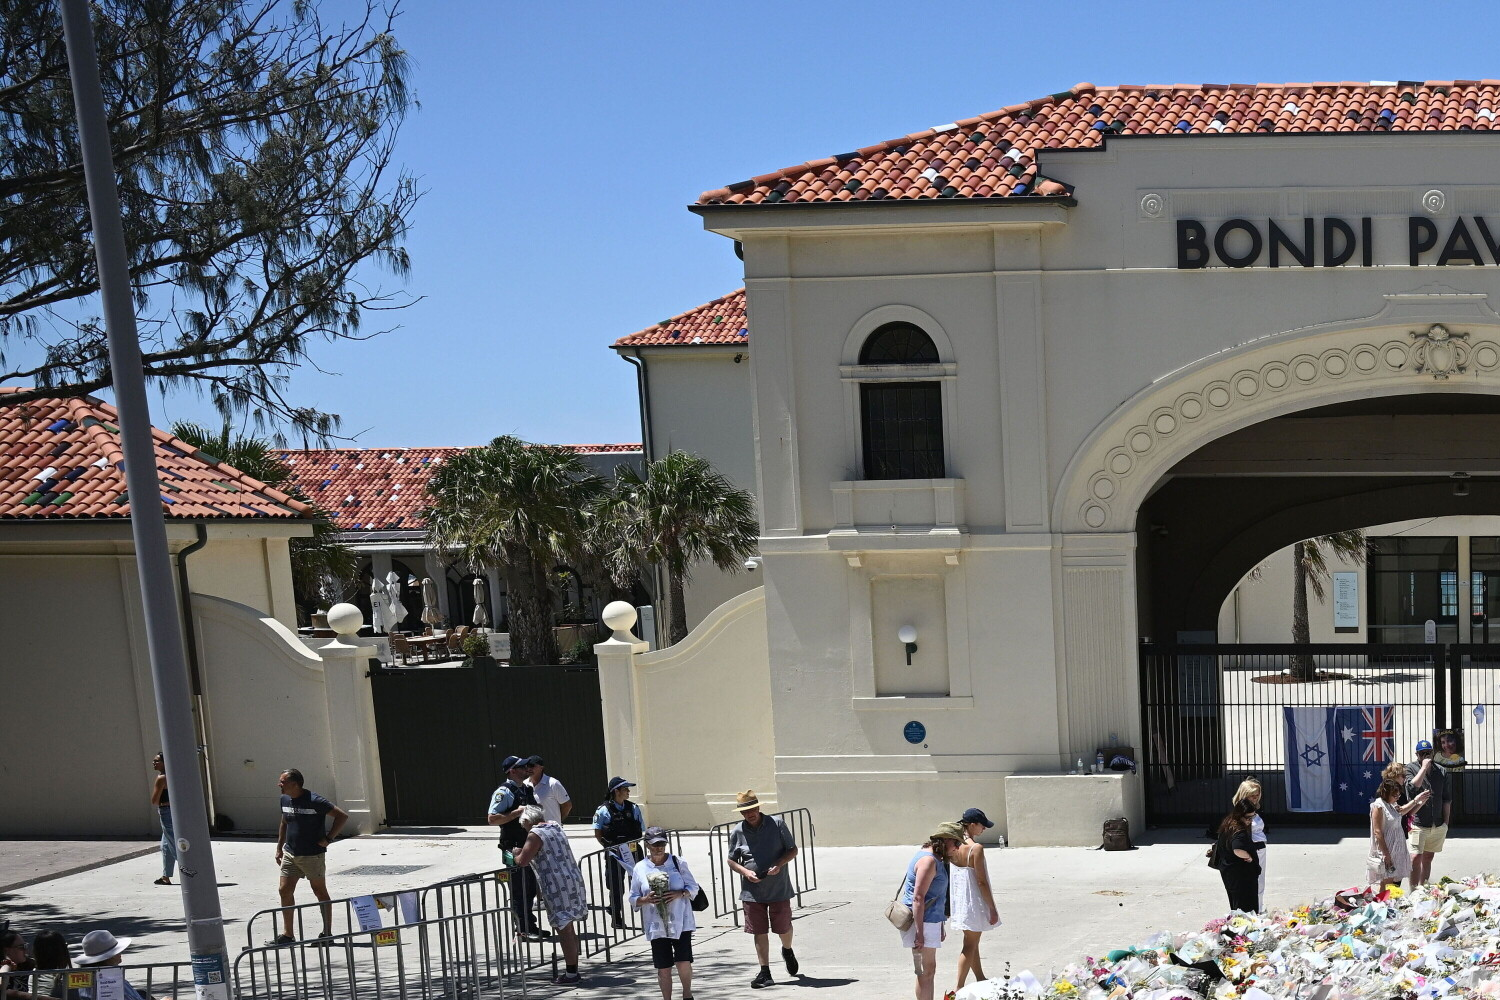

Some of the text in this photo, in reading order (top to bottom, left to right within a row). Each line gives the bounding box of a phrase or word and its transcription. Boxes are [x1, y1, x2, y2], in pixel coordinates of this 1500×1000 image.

[1176, 217, 1373, 269] BONDI
[377, 931, 396, 941] TFH
[70, 973, 90, 984] TFH
